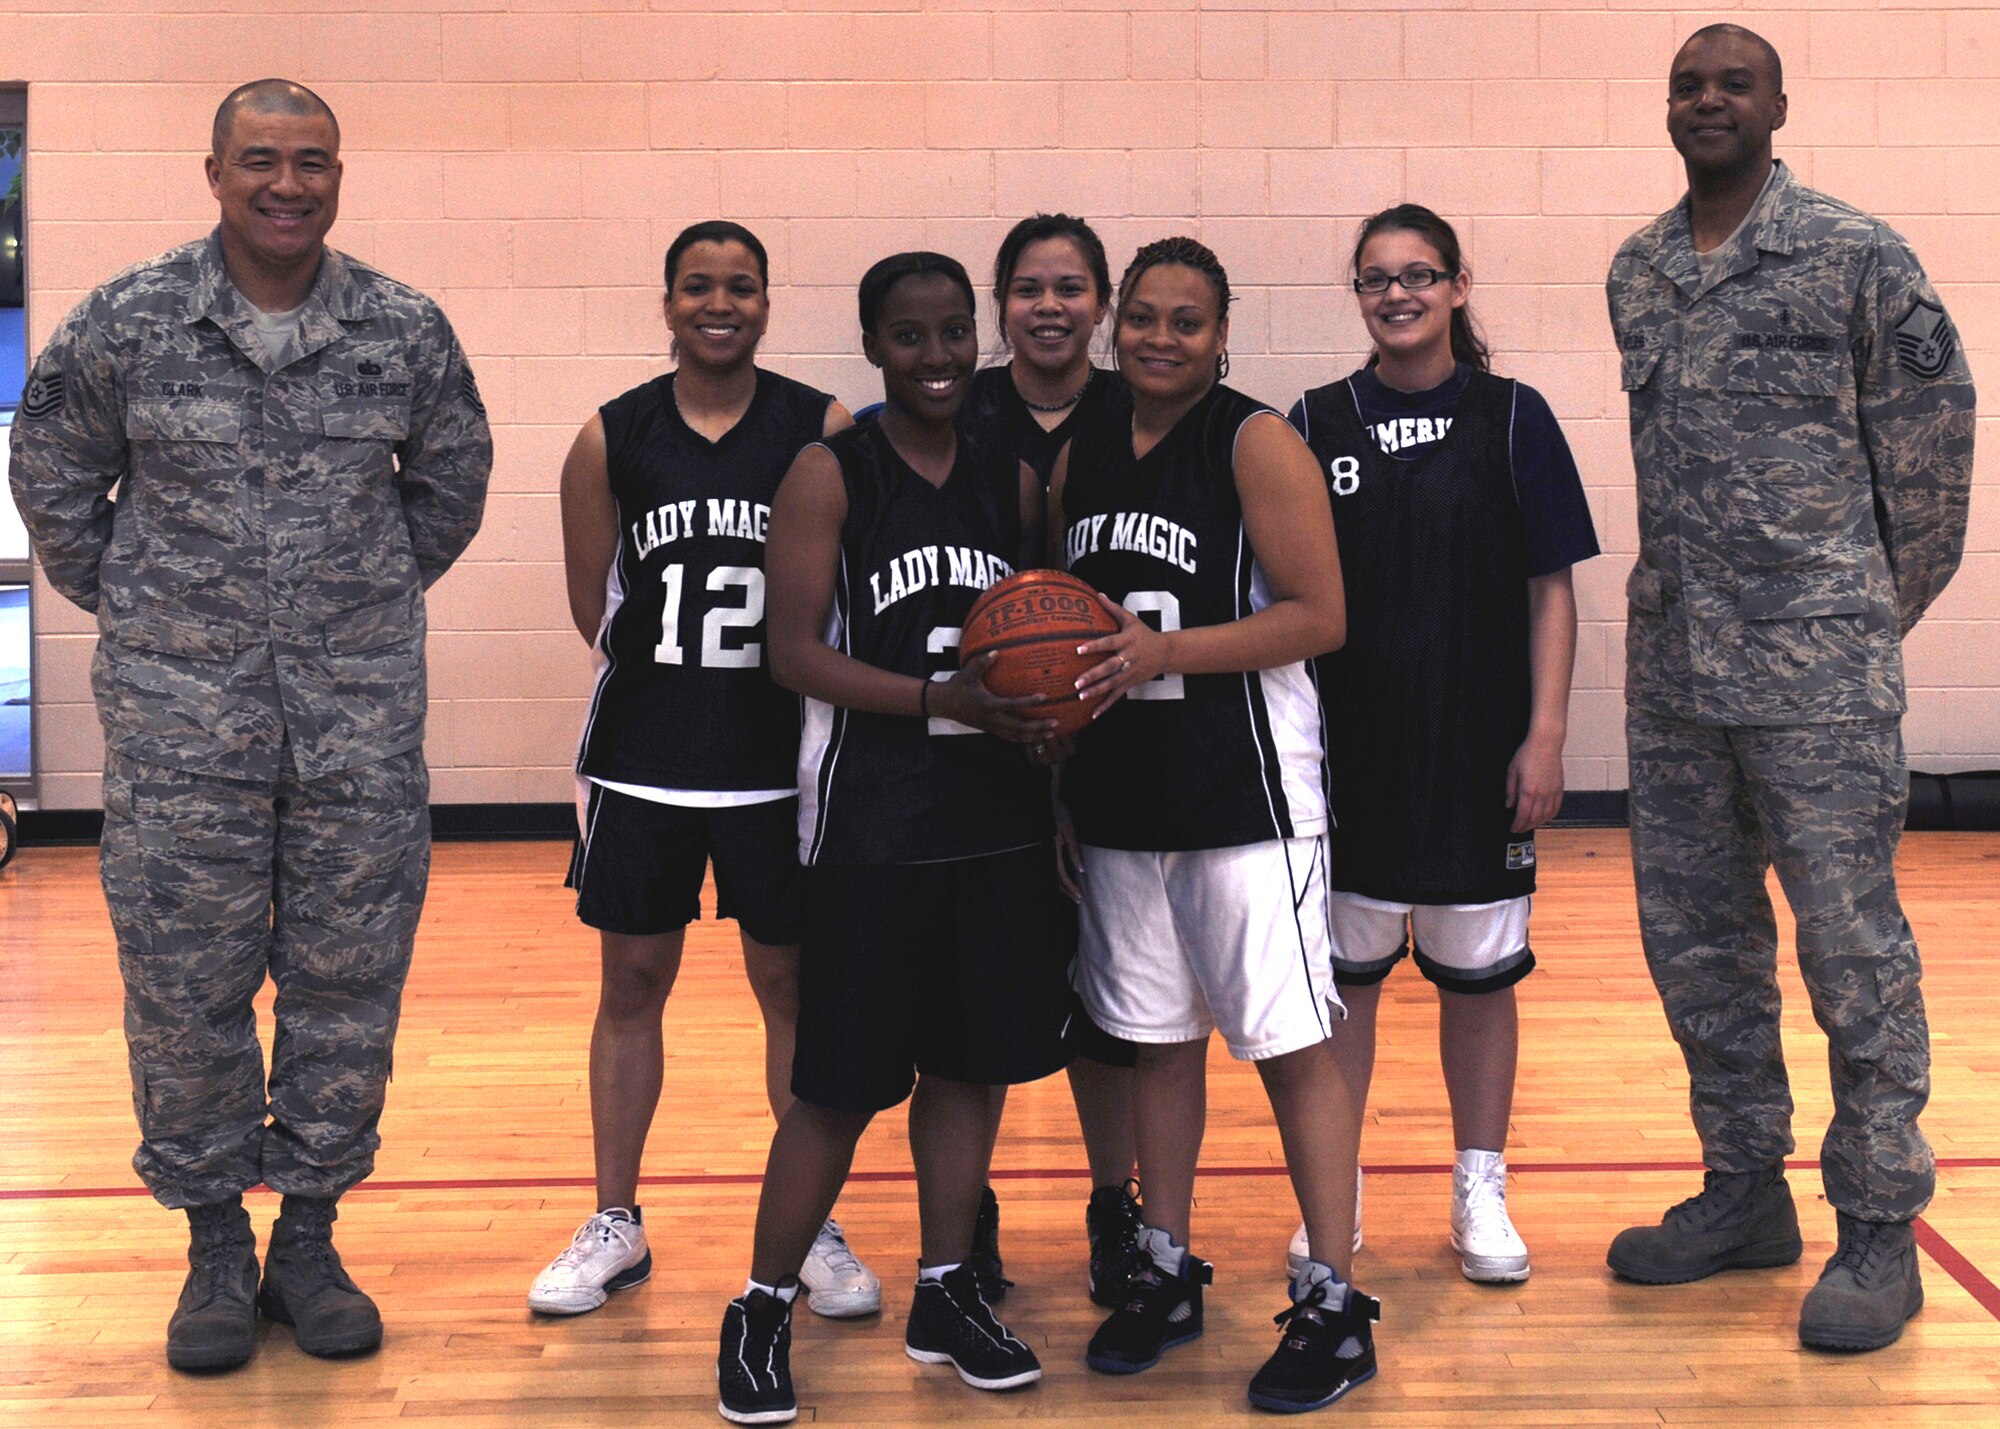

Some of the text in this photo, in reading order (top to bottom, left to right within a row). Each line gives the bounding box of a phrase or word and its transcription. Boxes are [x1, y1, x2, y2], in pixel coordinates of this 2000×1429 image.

[1765, 334, 1787, 348] AIR
[1789, 334, 1829, 350] FORCE
[161, 382, 205, 399] CLARK
[358, 382, 378, 397] AIR
[1331, 456, 1360, 496] 8
[632, 498, 771, 561] LADY MAG
[1065, 512, 1197, 575] ADY MAGIC
[869, 545, 1016, 616] LADY MAG
[654, 564, 766, 669] 12
[985, 596, 1090, 628] TF-1000
